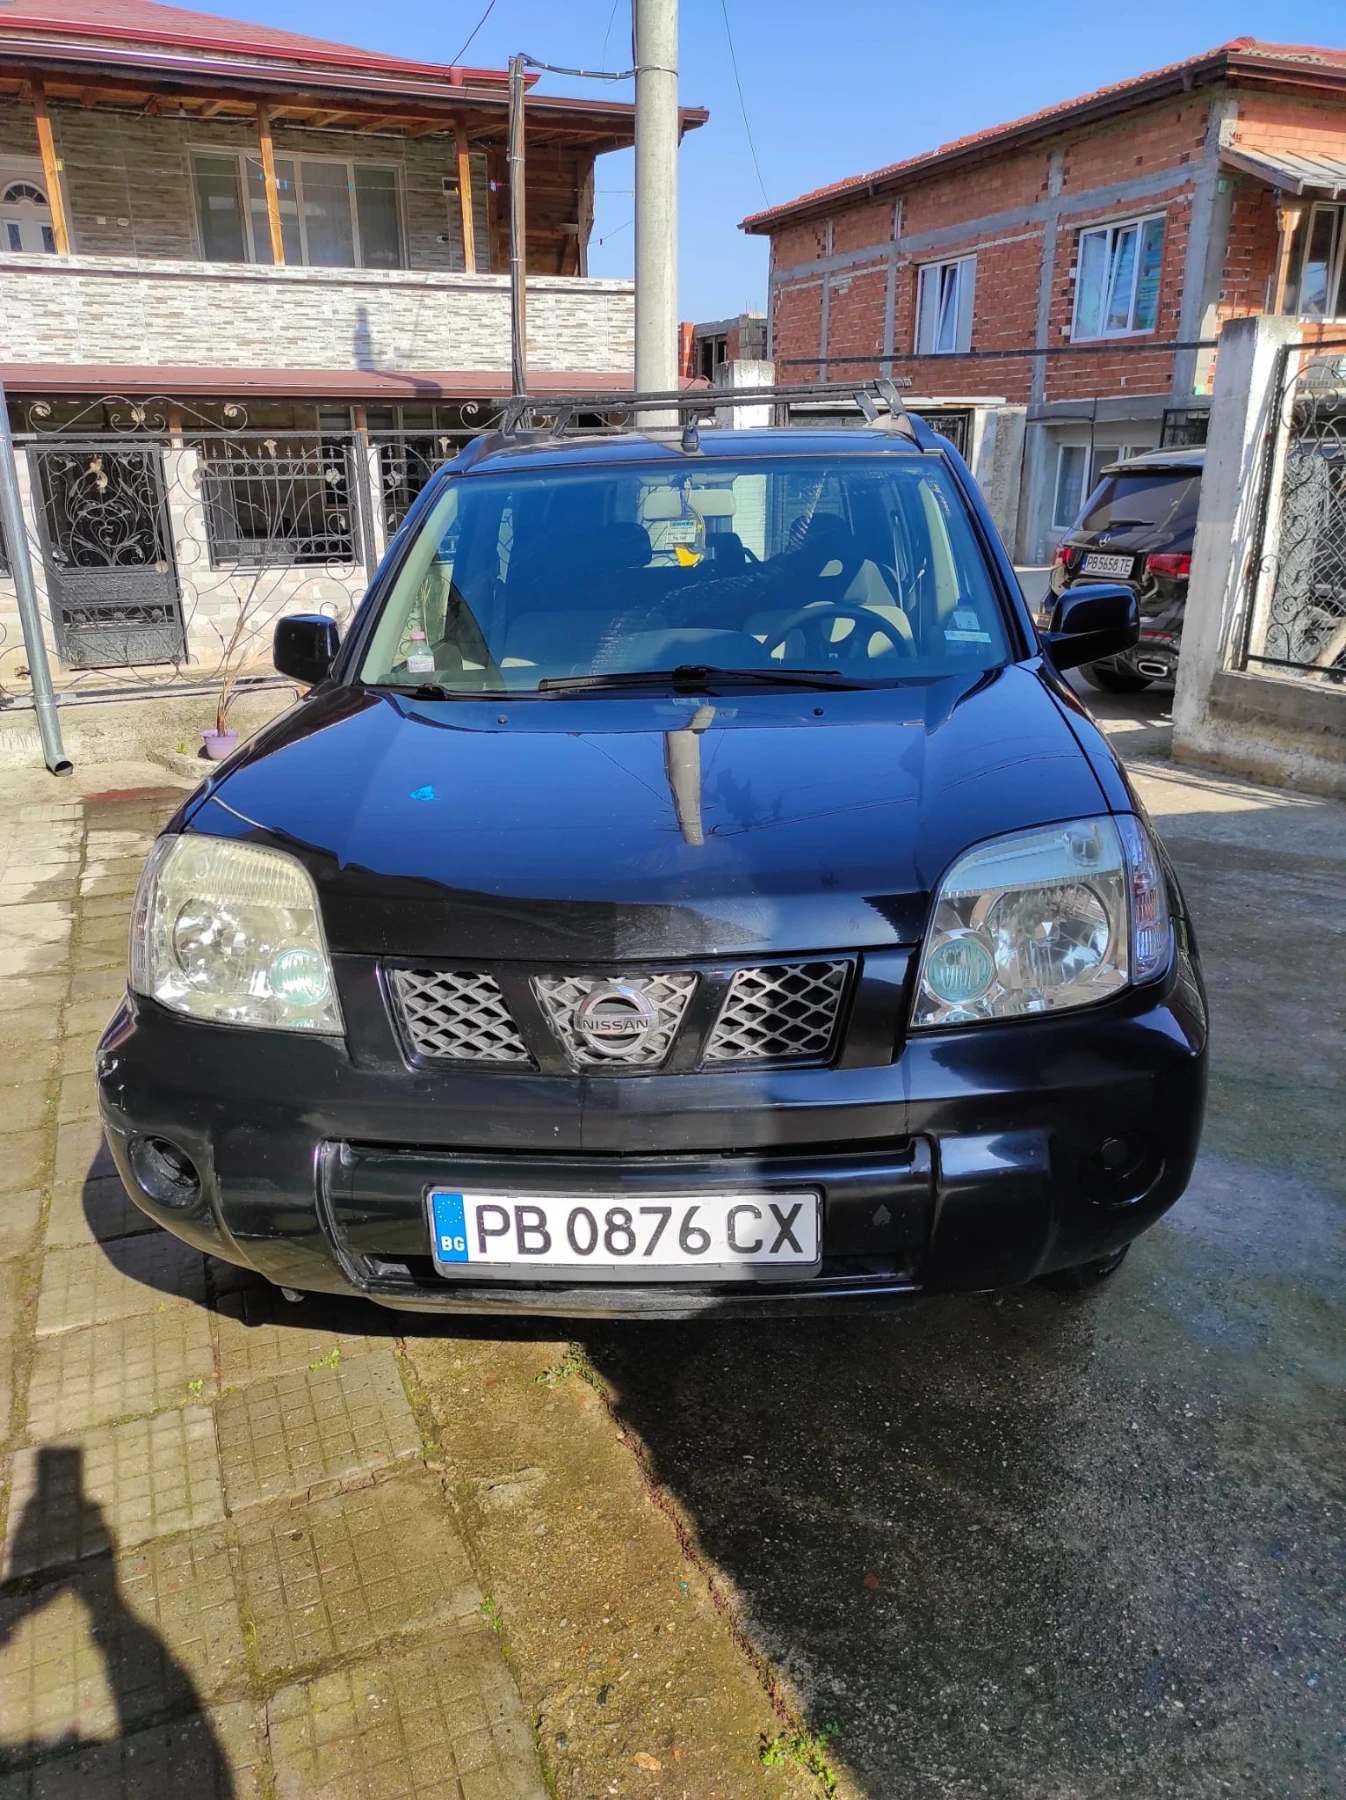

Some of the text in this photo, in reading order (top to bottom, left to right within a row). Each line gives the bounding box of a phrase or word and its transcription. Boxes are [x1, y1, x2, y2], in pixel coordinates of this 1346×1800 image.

[1086, 556, 1132, 573] PB 5658 TE
[583, 1019, 648, 1031] NISSAN
[476, 1203, 804, 1257] PB 0876 CX
[441, 1235, 465, 1252] BG
